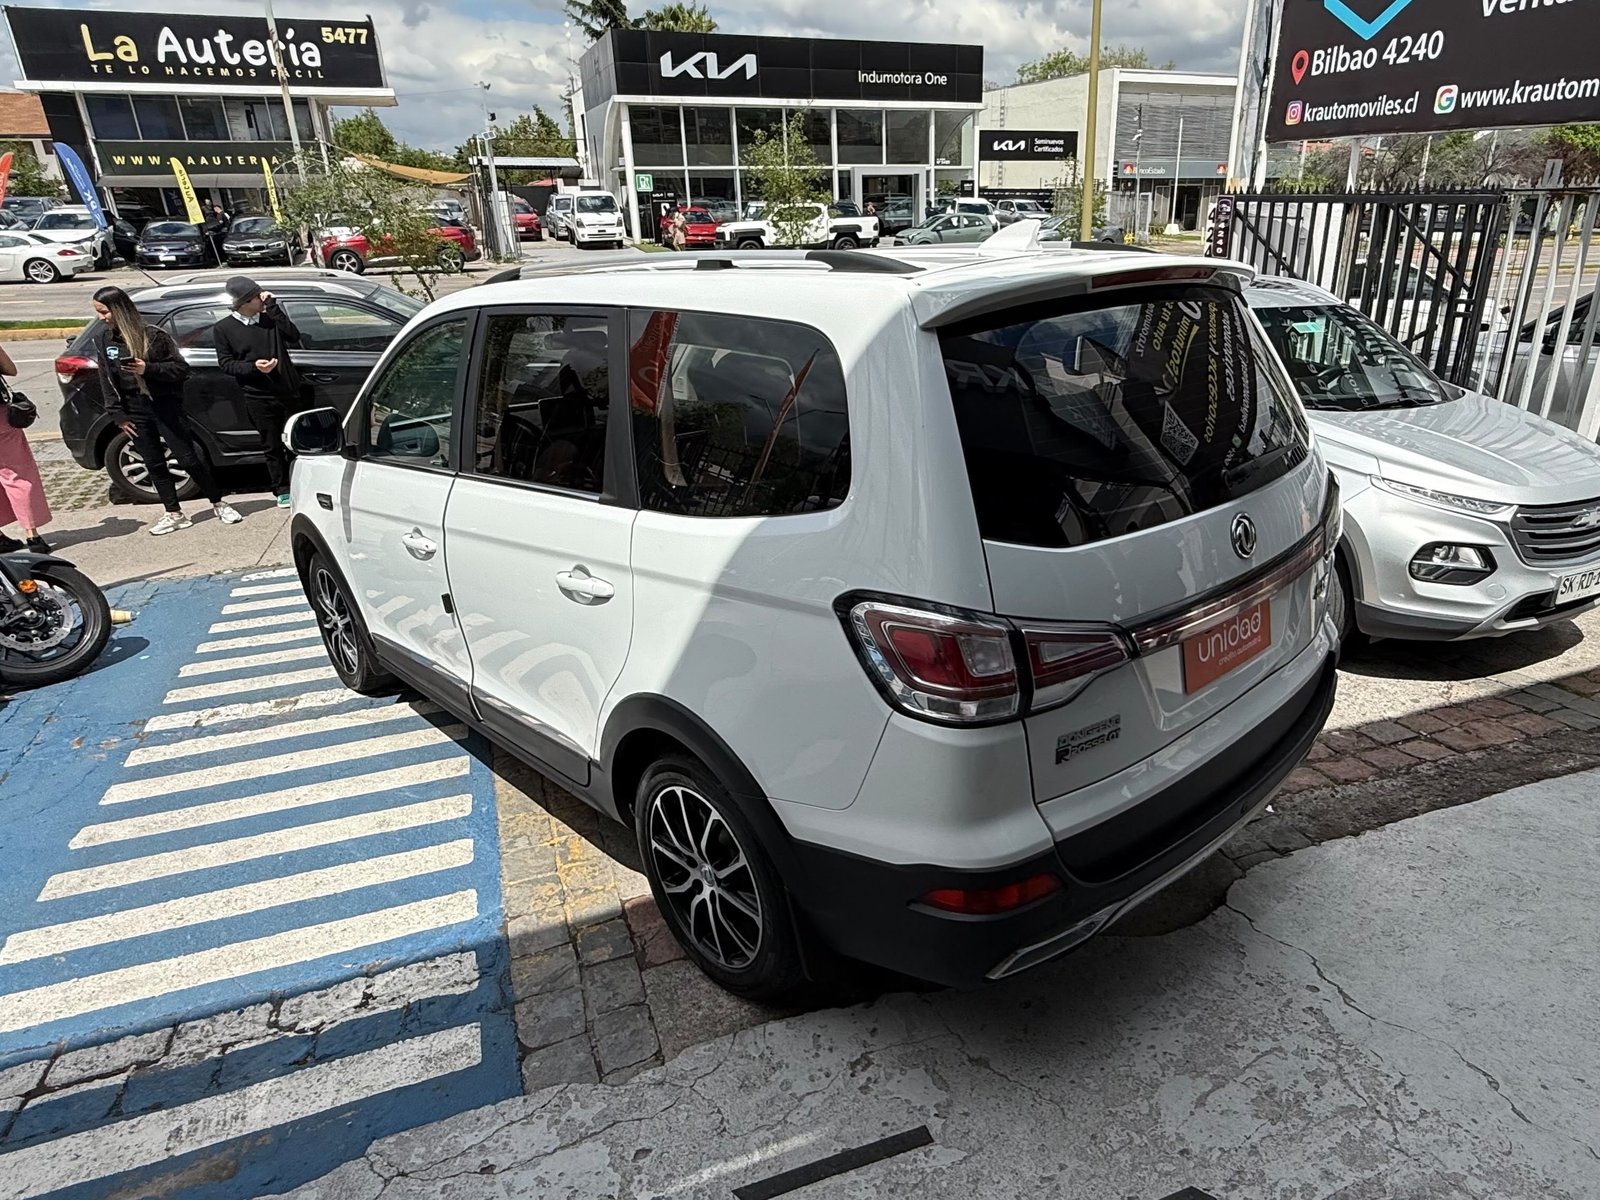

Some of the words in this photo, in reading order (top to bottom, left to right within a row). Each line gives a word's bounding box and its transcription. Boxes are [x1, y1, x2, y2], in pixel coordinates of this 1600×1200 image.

[80, 23, 138, 62] La
[157, 26, 321, 67] Autería
[321, 27, 367, 45] 5477
[660, 50, 757, 80] KIA
[1311, 45, 1377, 76] Bilbao
[1382, 30, 1444, 65] 4240
[90, 64, 114, 74] TE
[128, 65, 150, 75] LO
[165, 66, 257, 77] HACEMOS
[858, 70, 922, 85] Indumotora
[925, 72, 948, 85] One
[1303, 91, 1420, 123] krautomoviles.cl
[993, 140, 1025, 151] KIA
[1198, 604, 1261, 663] unidad
